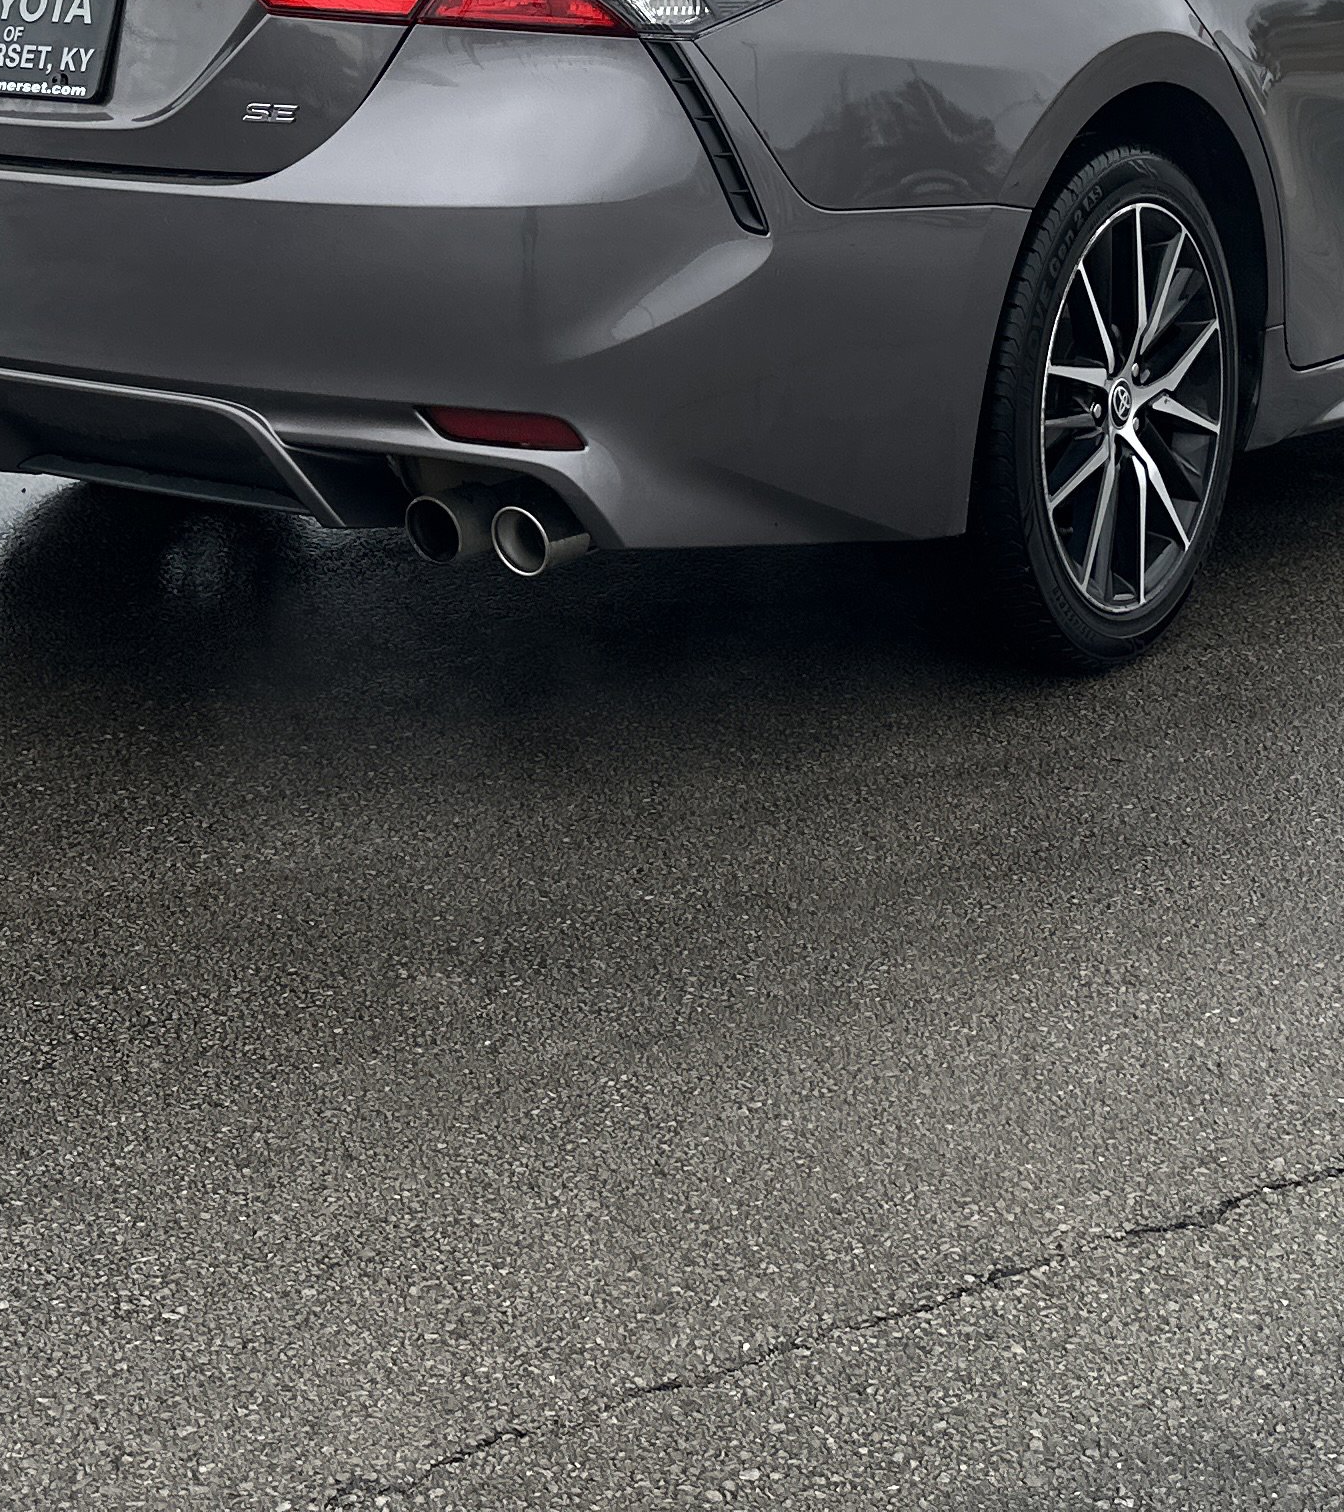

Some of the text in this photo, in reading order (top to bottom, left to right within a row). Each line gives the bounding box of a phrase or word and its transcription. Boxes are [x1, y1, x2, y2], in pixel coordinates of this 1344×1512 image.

[3, 25, 25, 42] OF
[59, 46, 96, 73] KY
[242, 102, 299, 124] SE
